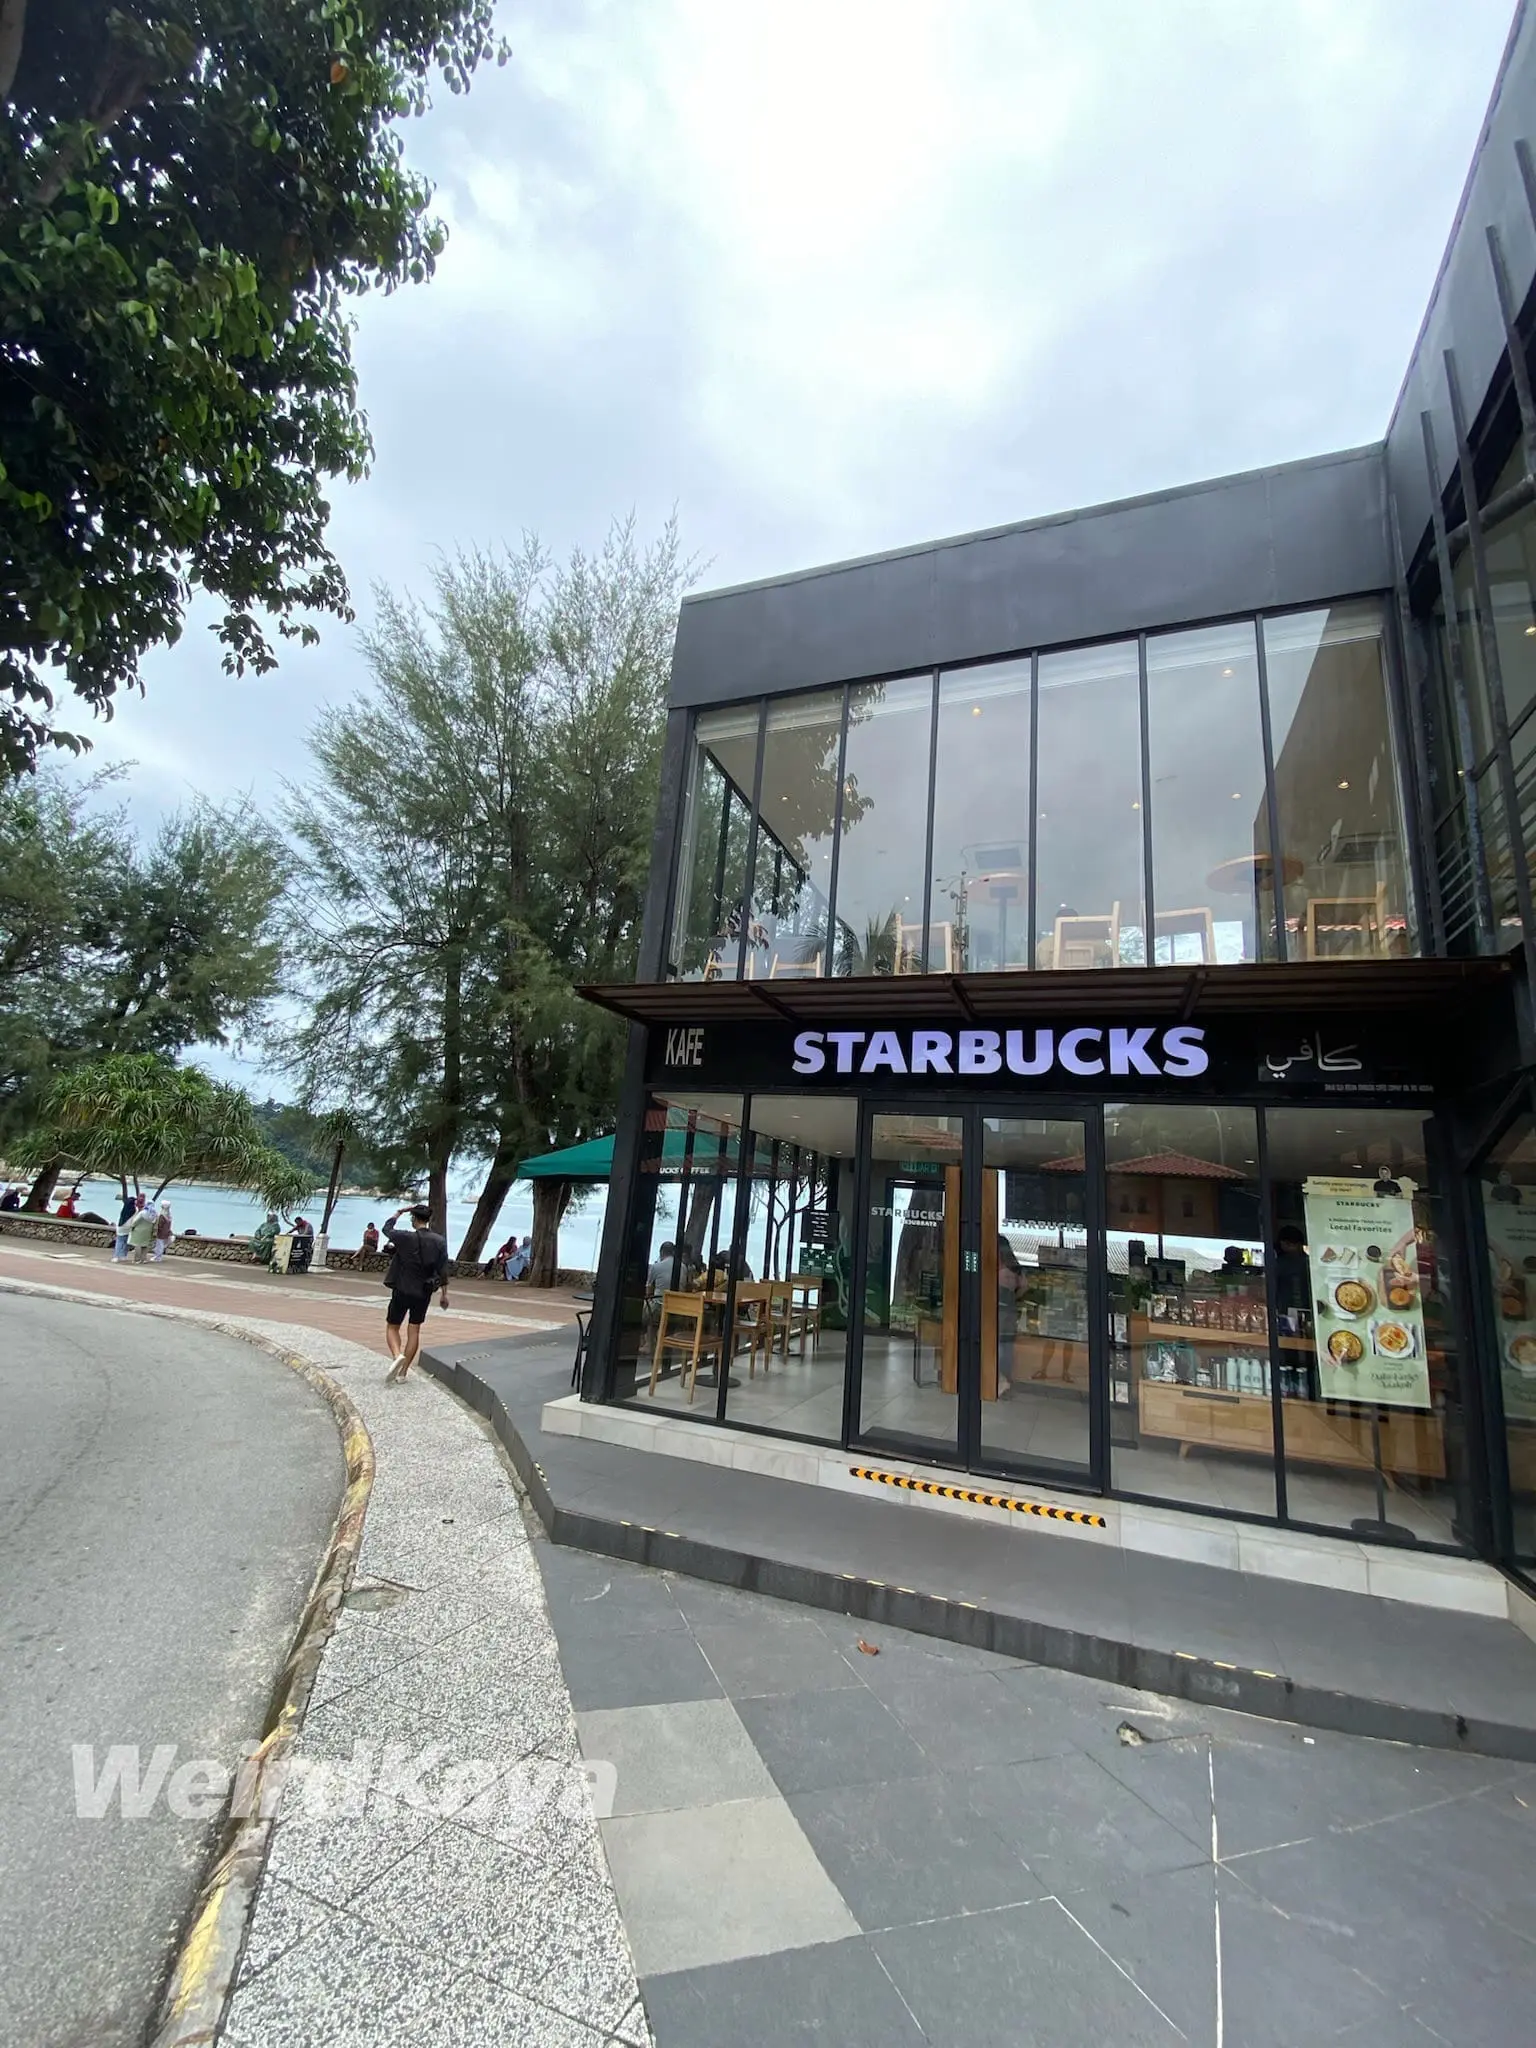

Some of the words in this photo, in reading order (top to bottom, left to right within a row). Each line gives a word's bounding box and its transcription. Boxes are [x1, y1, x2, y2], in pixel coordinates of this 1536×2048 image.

[665, 1028, 704, 1065] KAFE
[791, 1026, 1209, 1077] STARBUCKS
[1266, 1030, 1362, 1079] كافي
[871, 1206, 943, 1221] STARBUCKS
[1002, 1218, 1084, 1232] STARBUCKS
[1330, 1223, 1351, 1231] Local
[1353, 1224, 1392, 1234] Favorites
